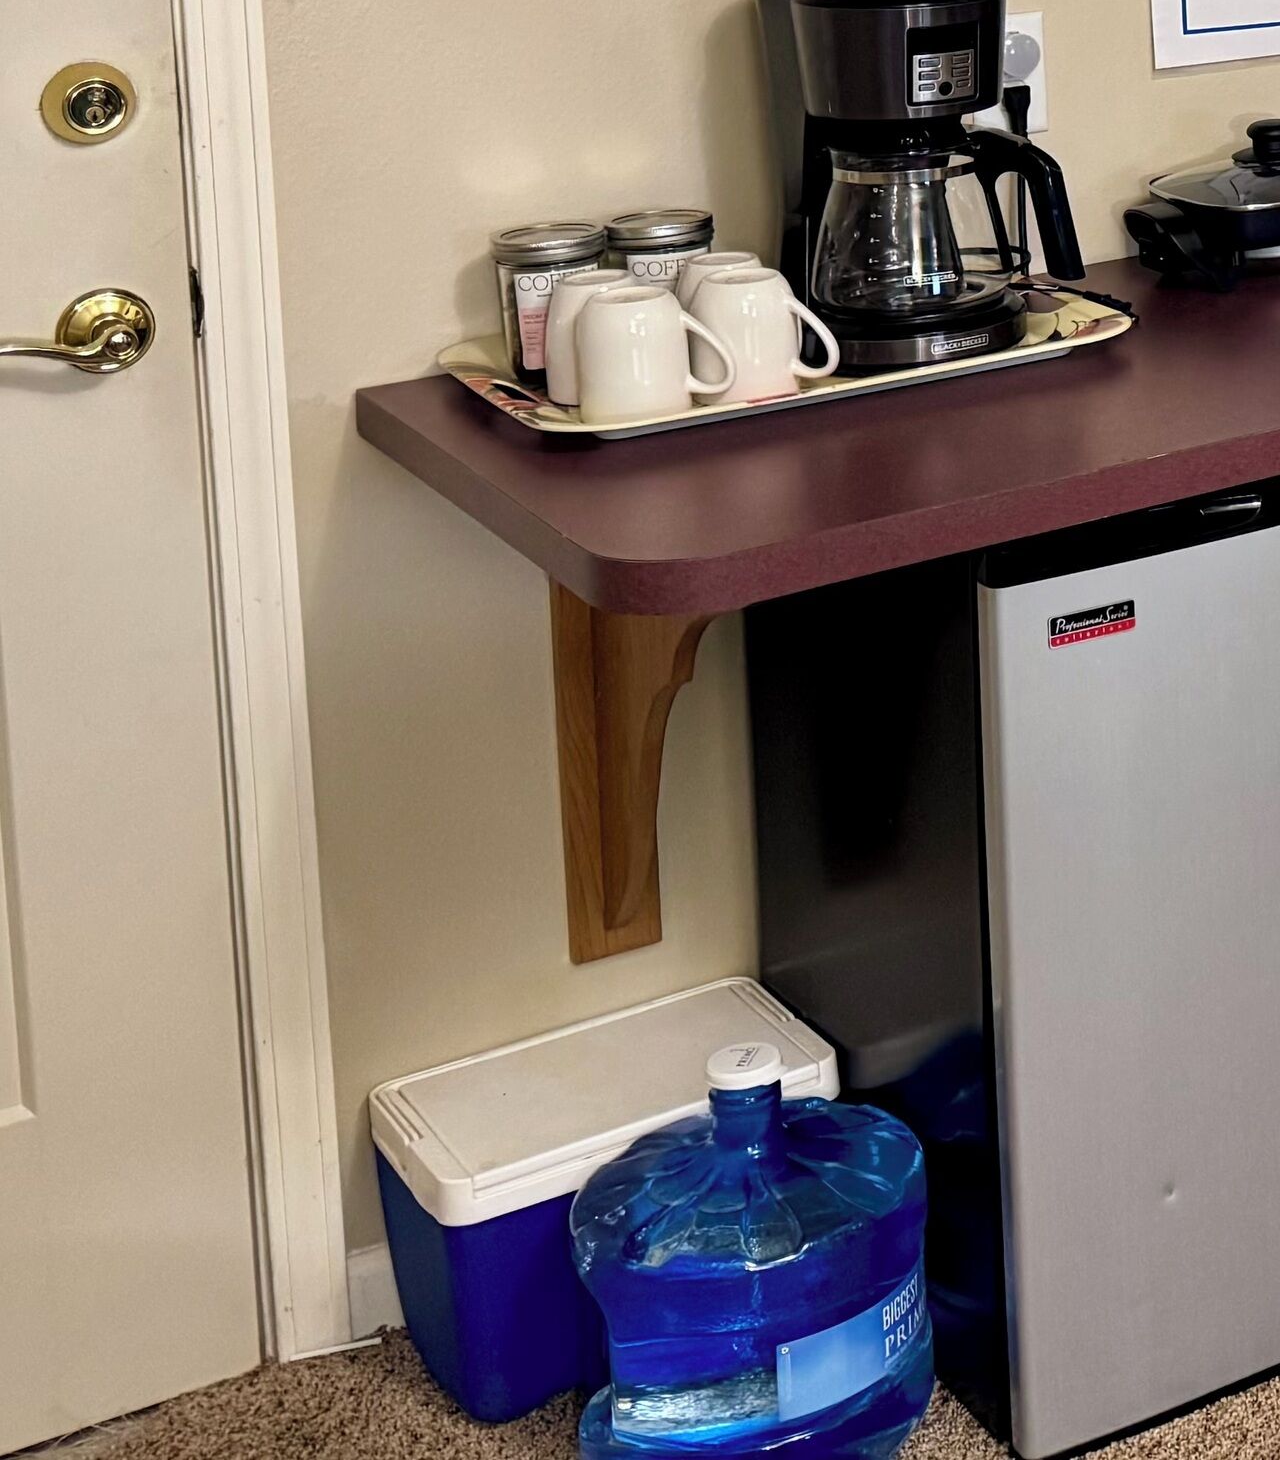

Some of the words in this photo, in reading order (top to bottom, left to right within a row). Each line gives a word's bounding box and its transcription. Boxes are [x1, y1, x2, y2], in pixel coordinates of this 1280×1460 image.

[1055, 614, 1104, 634] Professional
[1102, 605, 1129, 623] Series
[882, 1271, 919, 1332] BIGGEST
